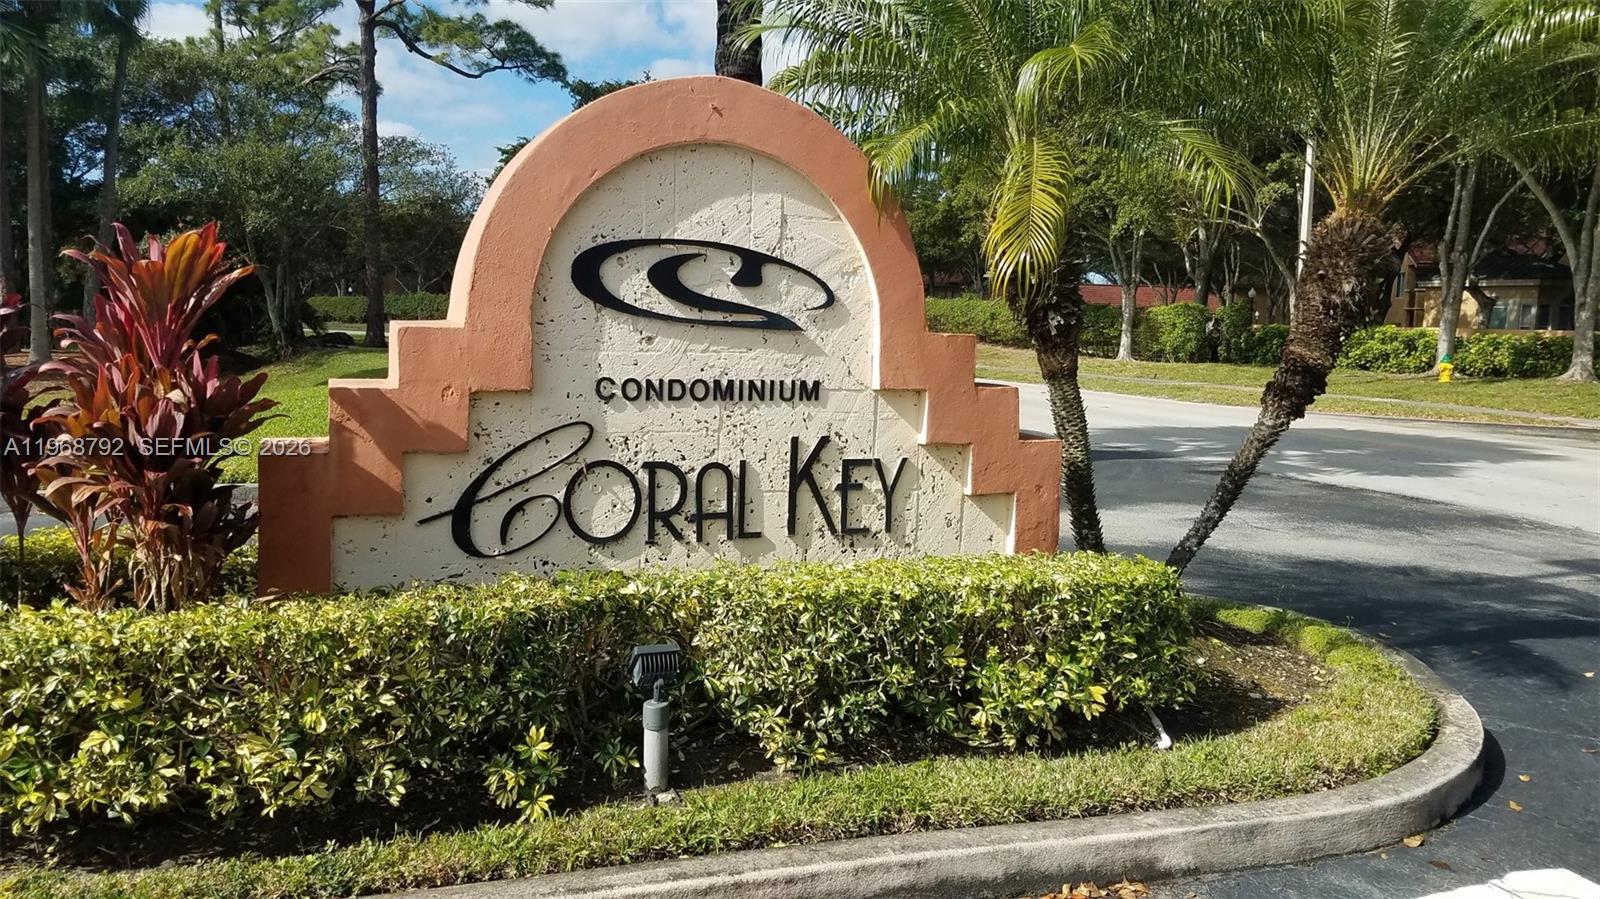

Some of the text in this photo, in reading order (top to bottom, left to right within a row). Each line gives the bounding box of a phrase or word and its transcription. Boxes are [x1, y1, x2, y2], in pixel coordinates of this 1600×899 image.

[595, 376, 822, 403] CONDOMINIUM
[416, 421, 908, 558] CORAL KEY
